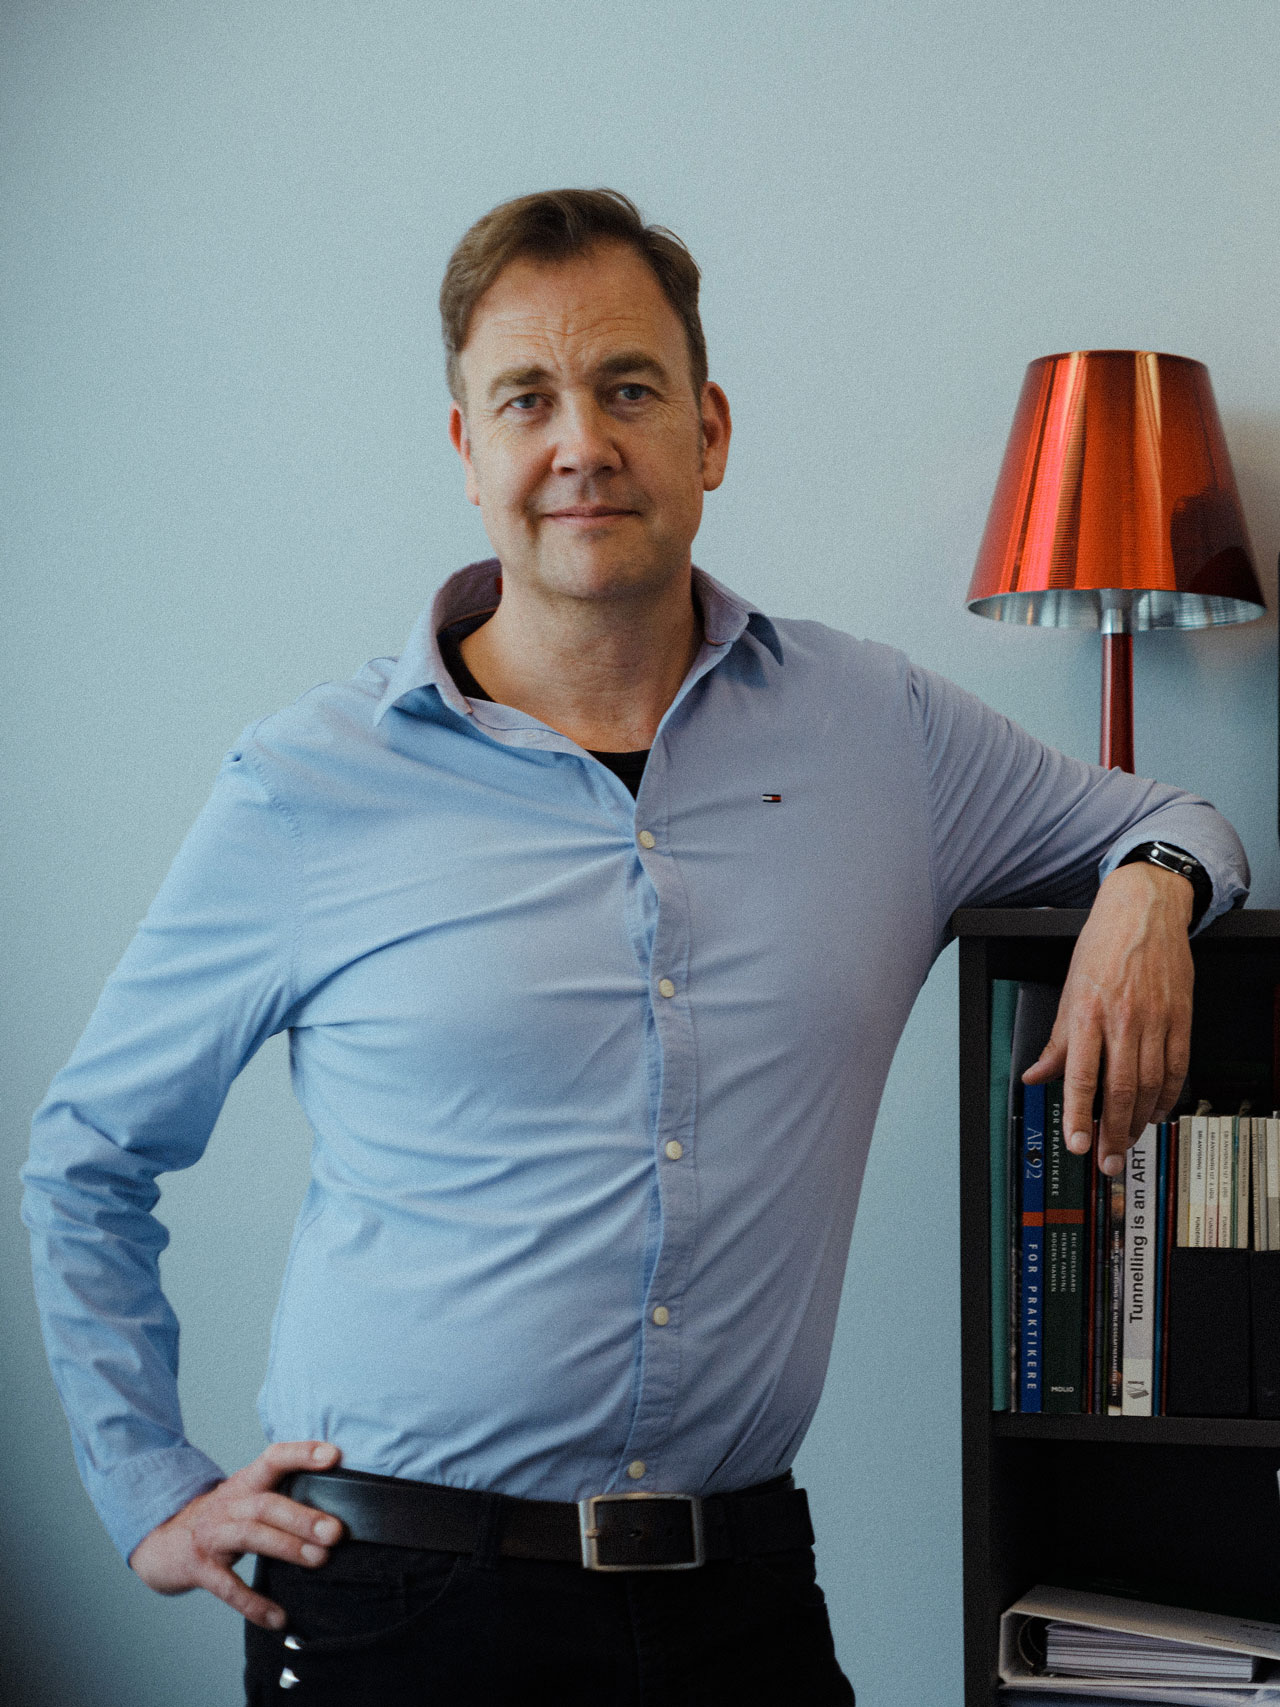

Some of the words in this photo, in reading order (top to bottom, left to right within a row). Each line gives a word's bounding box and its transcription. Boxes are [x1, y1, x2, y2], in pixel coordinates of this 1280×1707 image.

[1052, 1104, 1060, 1124] FOR
[1026, 1128, 1043, 1151] AB
[1026, 1159, 1042, 1179] 92
[1051, 1129, 1060, 1197] PRAKTIKERE
[1131, 1147, 1146, 1183] ART
[1132, 1189, 1146, 1210] an
[1130, 1215, 1145, 1230] is
[1028, 1244, 1039, 1273] FOR
[1129, 1236, 1148, 1324] Tunnelling
[1027, 1286, 1038, 1390] PRAKTIKERE
